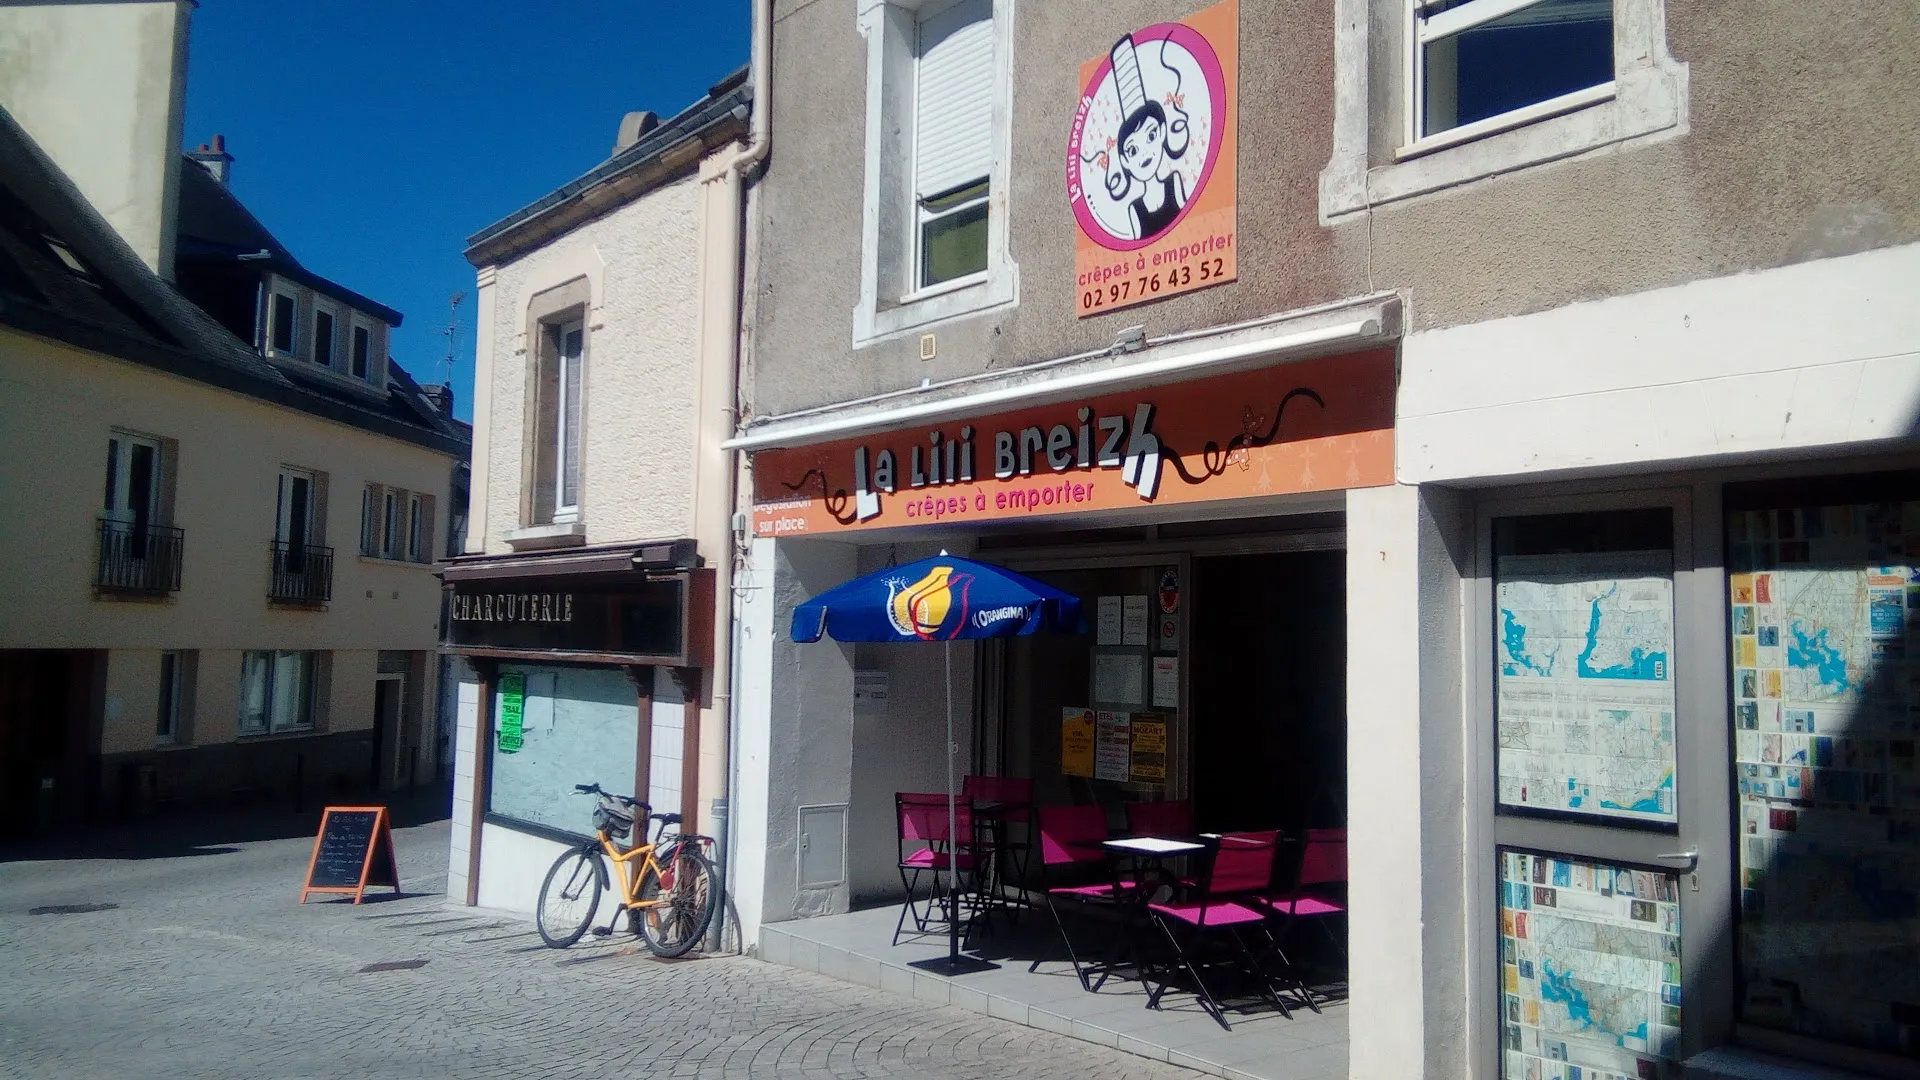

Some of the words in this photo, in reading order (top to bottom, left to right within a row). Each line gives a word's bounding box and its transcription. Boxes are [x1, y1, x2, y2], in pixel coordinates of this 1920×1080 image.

[1068, 154, 1077, 179] Lili
[1070, 183, 1082, 204] La
[1078, 259, 1129, 286] crêpes
[1136, 252, 1146, 271] à
[1153, 232, 1233, 265] emporter
[1083, 289, 1103, 308] 02
[1110, 282, 1131, 303] 97
[1139, 274, 1161, 295] 76
[1168, 266, 1191, 288] 43
[1200, 258, 1224, 280] 52
[855, 446, 894, 520] La
[910, 424, 973, 487] Lili
[995, 403, 1159, 499] Breizh
[905, 493, 967, 520] crêpes
[974, 487, 986, 511] à
[995, 480, 1095, 512] emporter
[759, 520, 773, 532] sur
[774, 516, 806, 535] place
[452, 593, 574, 622] CHARCUTERIE
